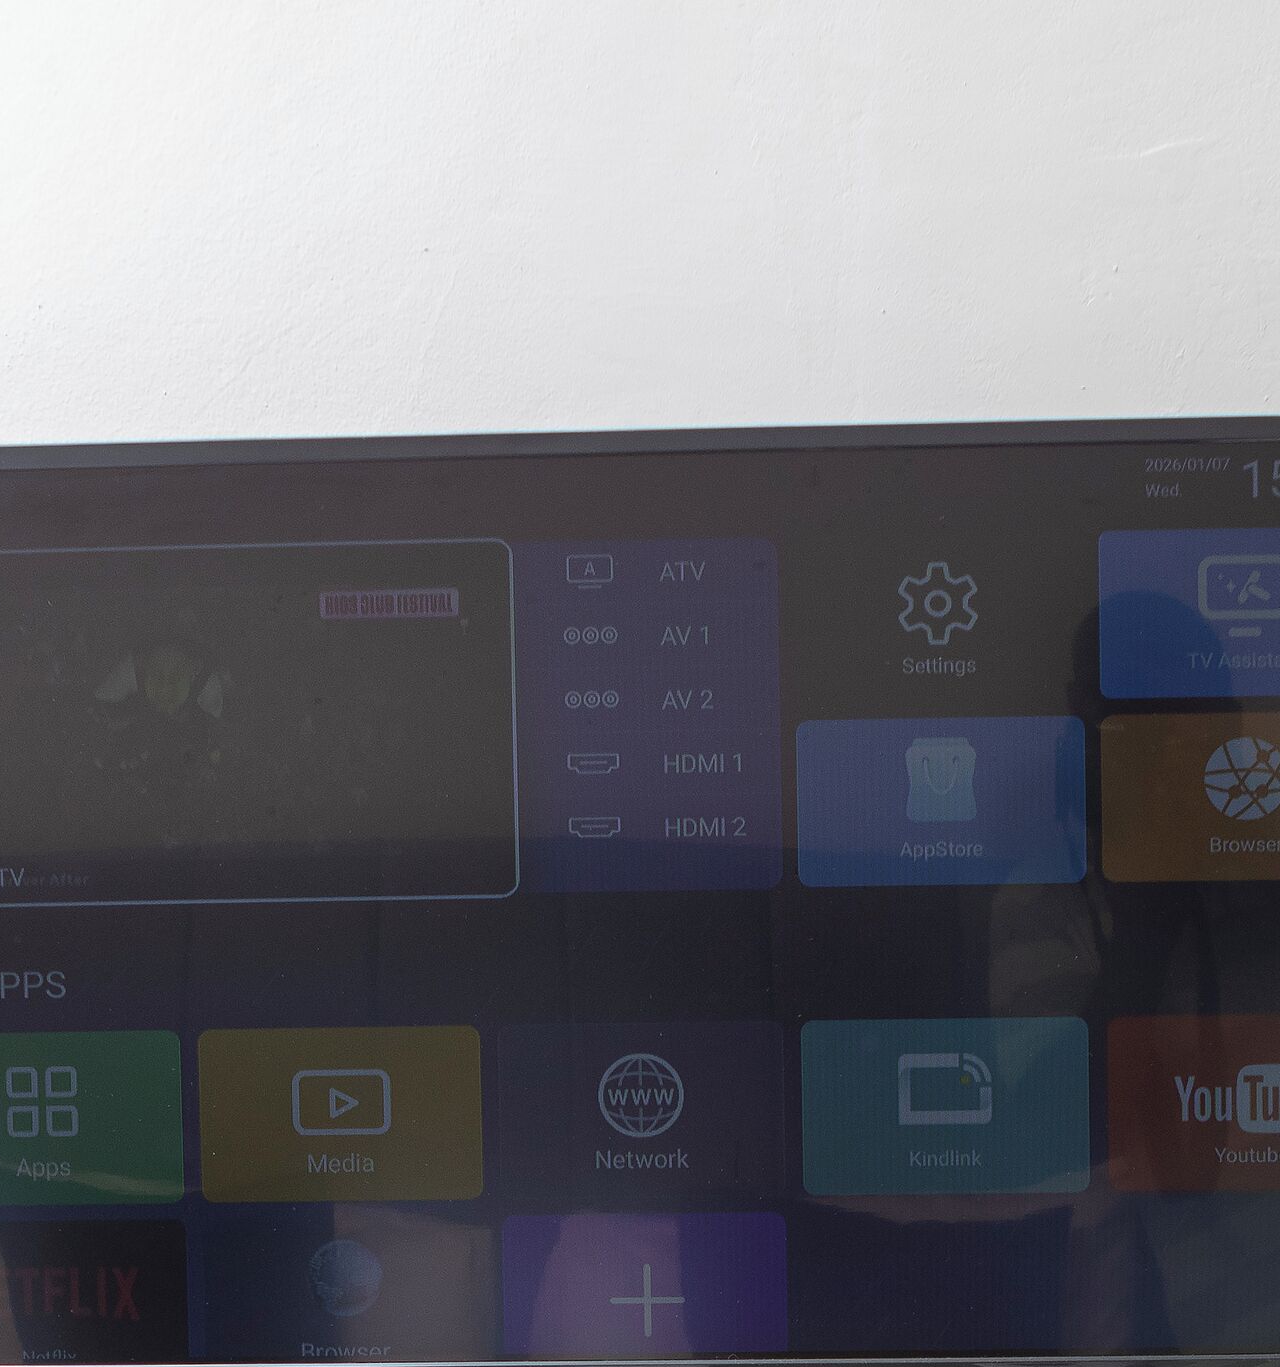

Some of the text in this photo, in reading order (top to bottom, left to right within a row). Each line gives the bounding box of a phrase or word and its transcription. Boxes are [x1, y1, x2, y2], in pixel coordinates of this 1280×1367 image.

[1144, 457, 1231, 473] 2026/01/07
[658, 561, 706, 582] ATV
[660, 625, 709, 646] AV 1
[901, 656, 977, 678] Settings
[1188, 652, 1214, 669] TV
[661, 689, 714, 711] AV 2
[663, 752, 742, 774] HDMI 1
[664, 816, 747, 838] HDMI 2
[899, 840, 984, 862] AppStore
[15, 1157, 72, 1181] Apps
[307, 1153, 375, 1174] Media
[595, 1148, 690, 1169] Network
[909, 1149, 982, 1168] Kindlink
